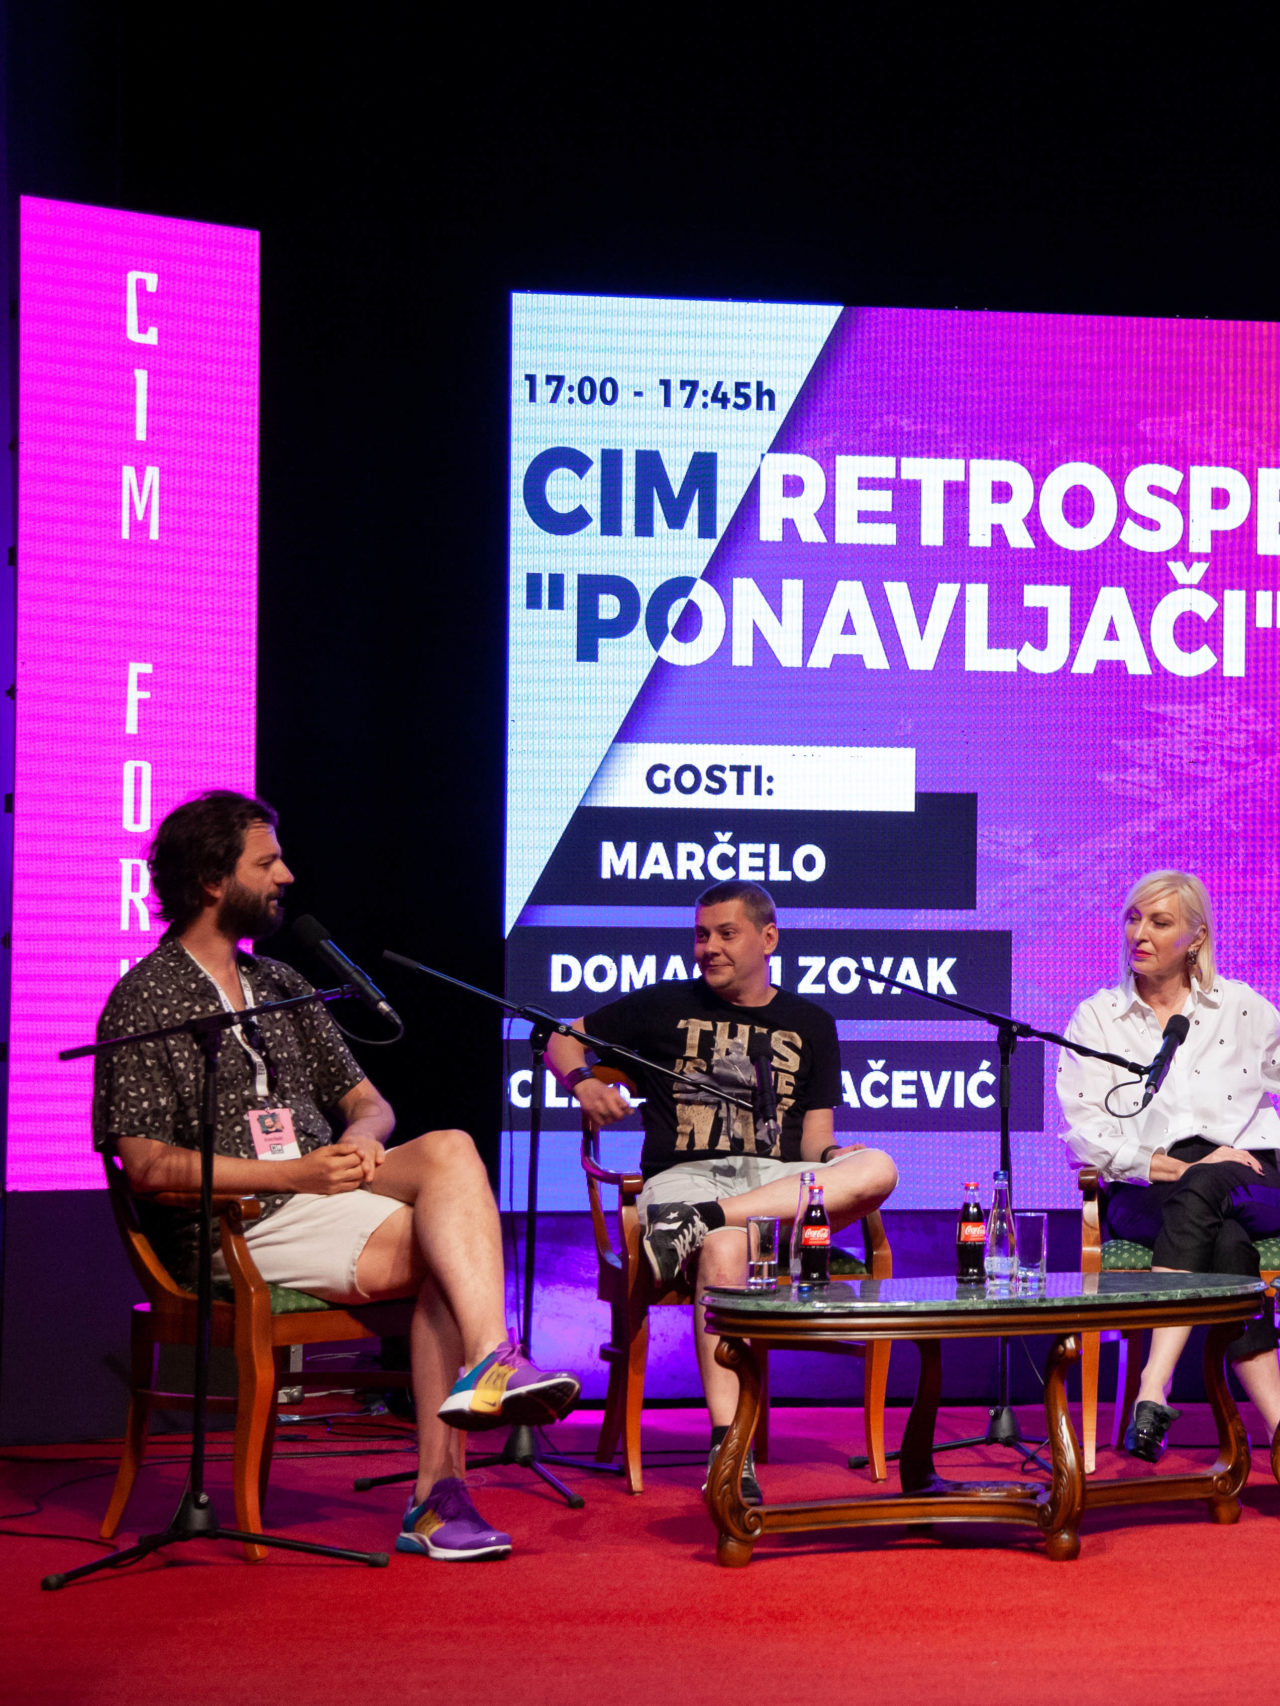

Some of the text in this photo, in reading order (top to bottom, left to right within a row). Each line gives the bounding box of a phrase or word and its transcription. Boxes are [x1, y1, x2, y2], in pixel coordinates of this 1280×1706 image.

[523, 373, 619, 406] 17:00
[658, 378, 776, 411] 17:45h
[522, 446, 718, 540] CIM
[119, 269, 159, 977] CIM FOR
[645, 763, 775, 797] GOSTI:
[600, 832, 827, 882] MARČELO
[797, 955, 958, 995] ZOVAK
[676, 1018, 803, 1073] THS
[834, 1059, 997, 1109] AČEVIĆ
